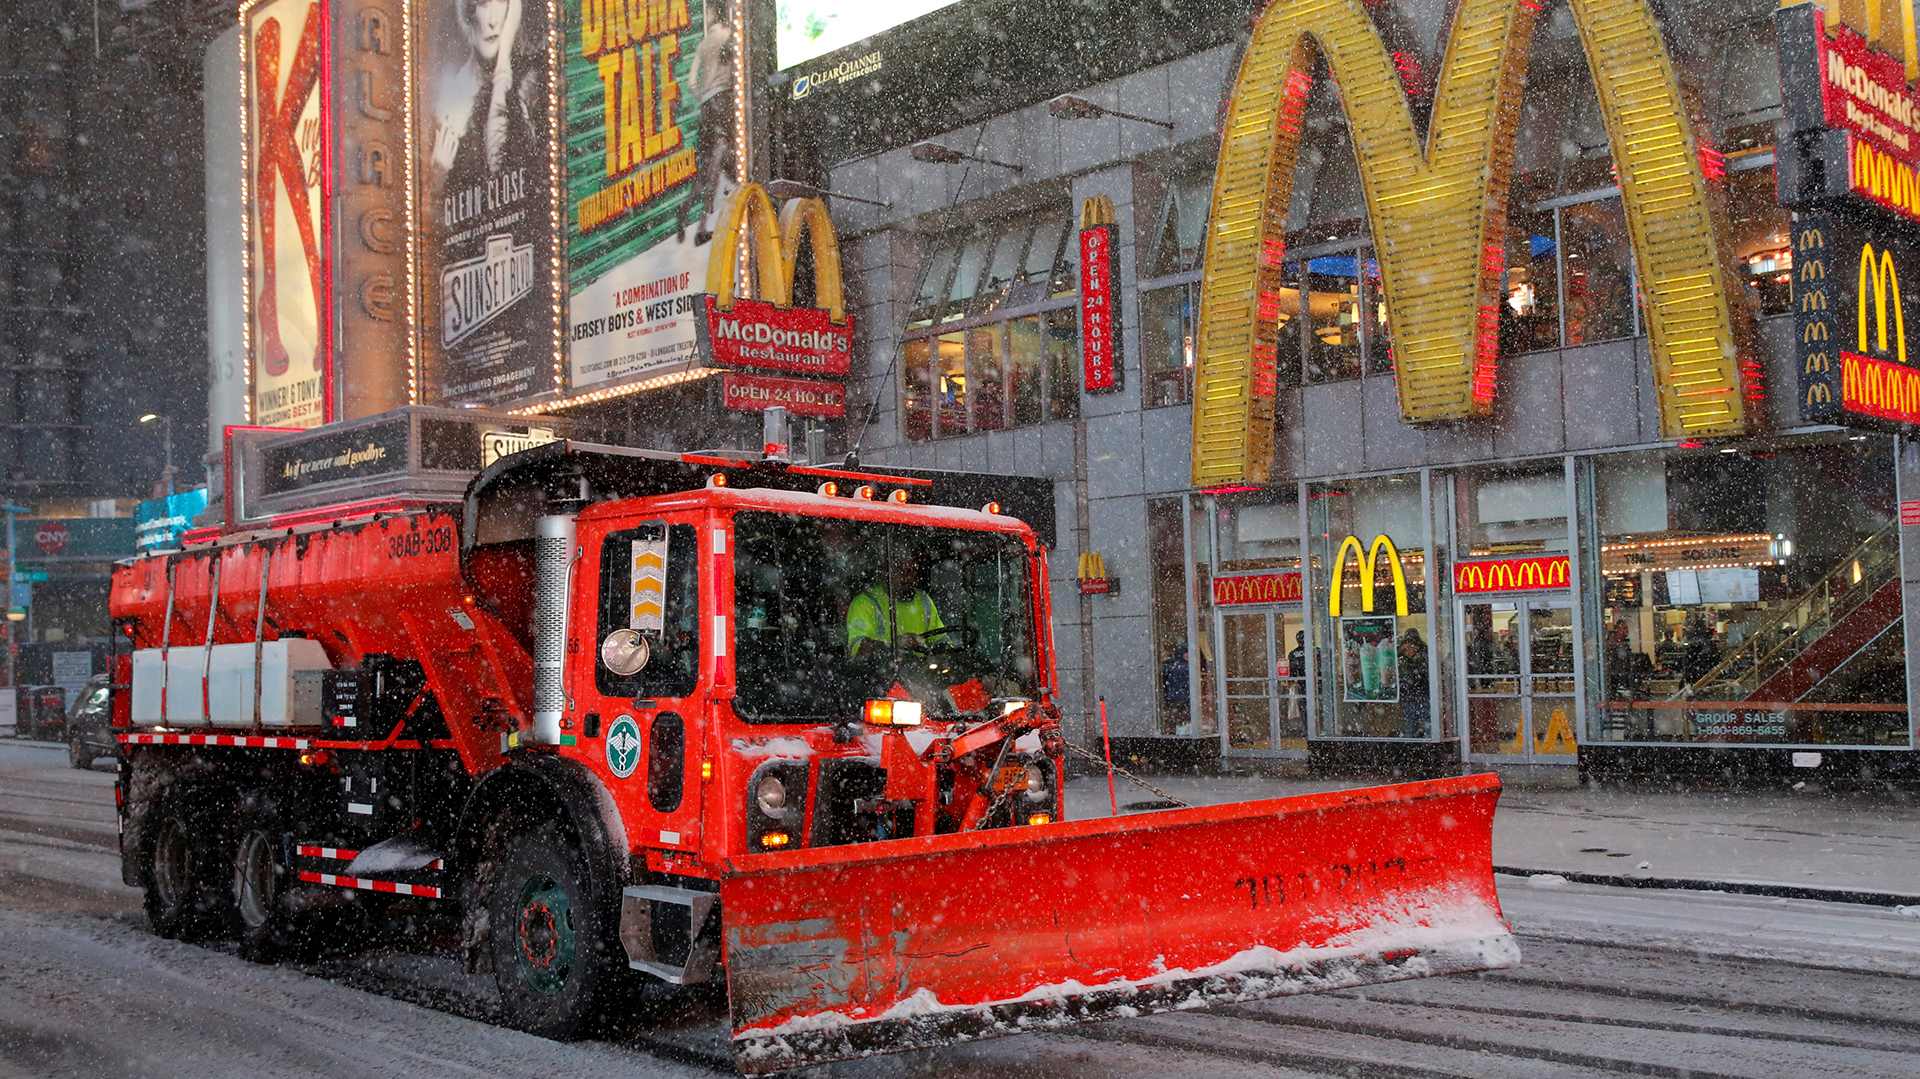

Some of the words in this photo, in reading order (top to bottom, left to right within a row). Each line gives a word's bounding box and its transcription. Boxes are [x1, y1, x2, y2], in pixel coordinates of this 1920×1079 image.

[838, 62, 882, 84] SPECTACOLOR
[598, 33, 682, 178] TALE
[1828, 50, 1920, 133] McDonald's
[1847, 101, 1909, 151] Restaurant
[445, 185, 482, 226] GLENN
[487, 167, 526, 210] CLOSE
[1088, 237, 1099, 290] OPEN
[451, 260, 506, 333] SUNSET
[622, 275, 678, 307] COMBINATION
[680, 272, 690, 290] OF
[1086, 295, 1104, 308] 24
[571, 317, 606, 342] JERSEY
[608, 310, 634, 333] BOYS
[635, 308, 644, 325] &
[645, 299, 674, 322] WEST
[717, 317, 848, 353] McDonald's
[740, 345, 826, 366] Restaurant
[1091, 313, 1102, 381] HOURS
[297, 377, 317, 402] TONY
[493, 366, 536, 386] ENGAGEMENT
[729, 384, 770, 401] OPEN
[775, 388, 792, 402] 24
[293, 402, 312, 418] BEST
[349, 443, 386, 469] goodbye.
[37, 531, 67, 543] CNY
[388, 526, 451, 559] 38AB-308
[1696, 713, 1737, 723] GROUP
[1744, 713, 1785, 723] SALES
[1697, 725, 1785, 735] 1-800-869-5455
